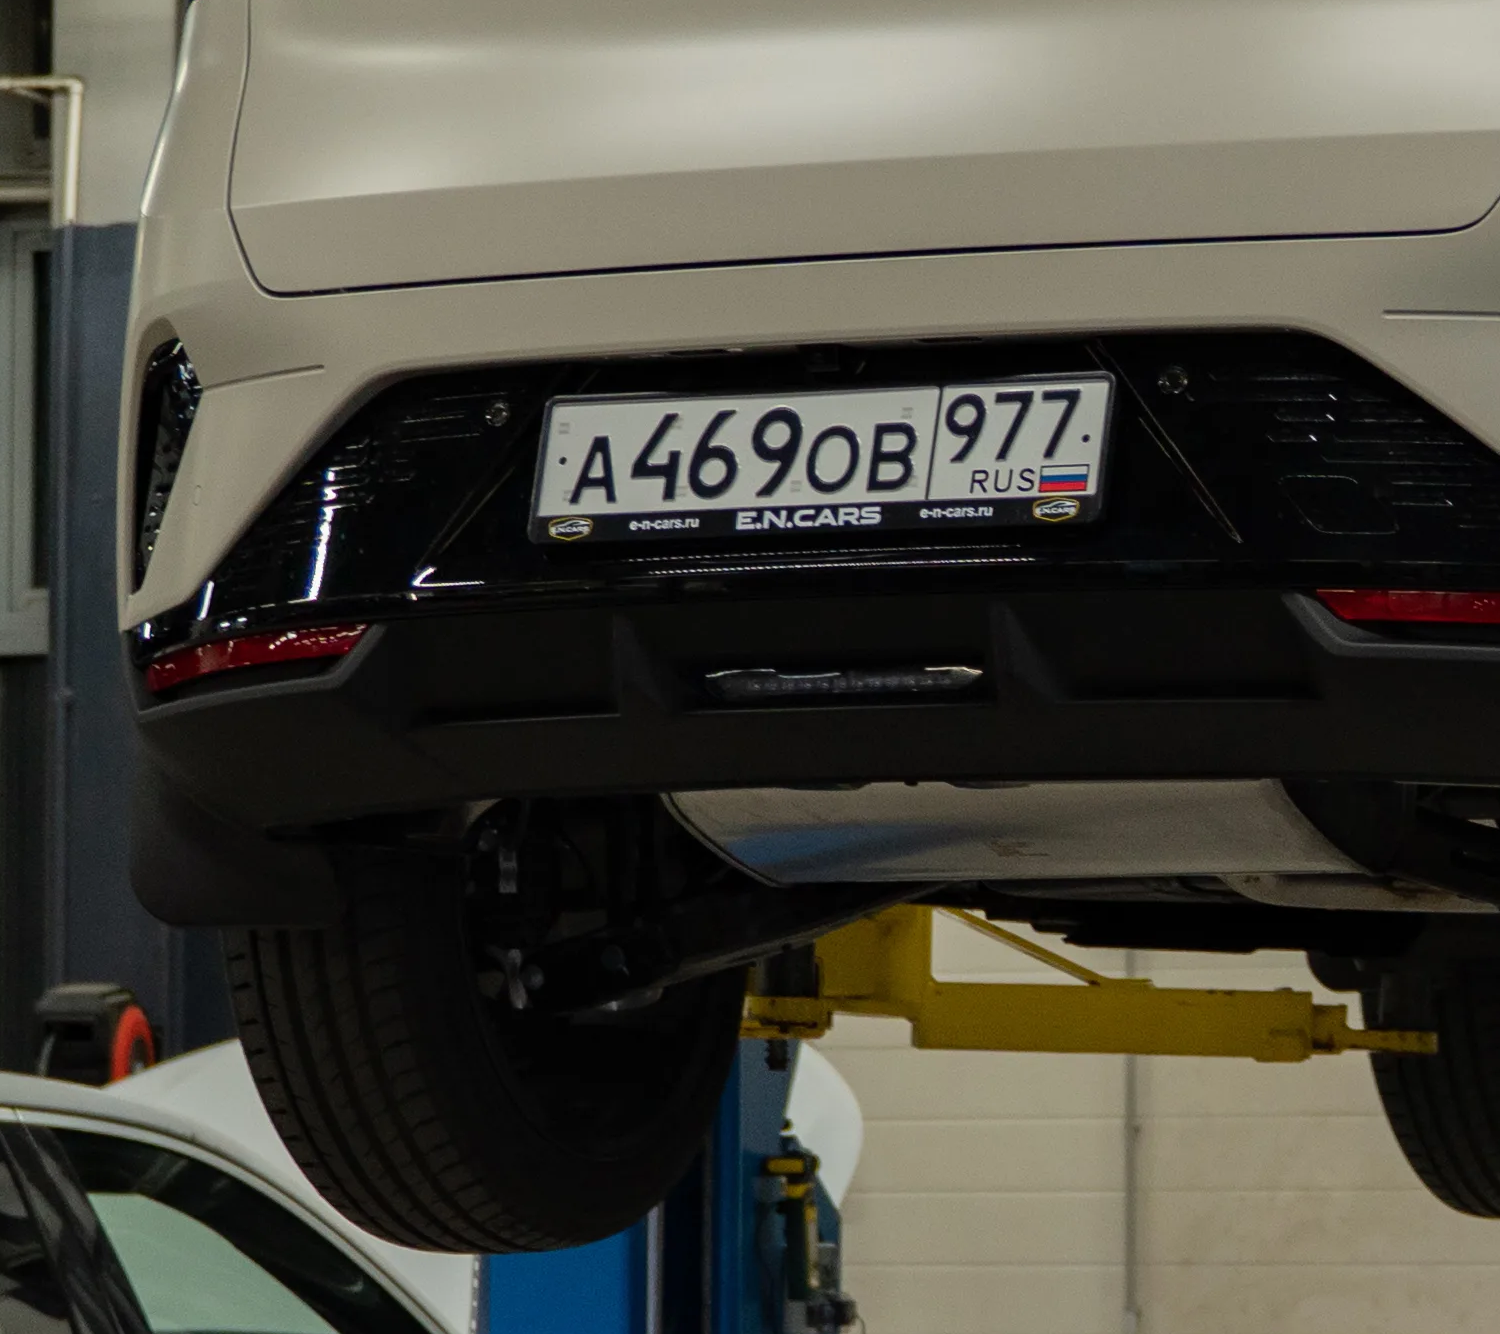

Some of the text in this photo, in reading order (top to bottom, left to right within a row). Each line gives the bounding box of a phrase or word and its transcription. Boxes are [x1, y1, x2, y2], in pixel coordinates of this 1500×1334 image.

[945, 390, 1081, 464] 977
[970, 468, 1035, 494] RUS
[629, 517, 700, 531] e-n-cars.ru
[735, 506, 882, 531] E.N.CARS
[919, 505, 994, 519] e-n-cars.ru
